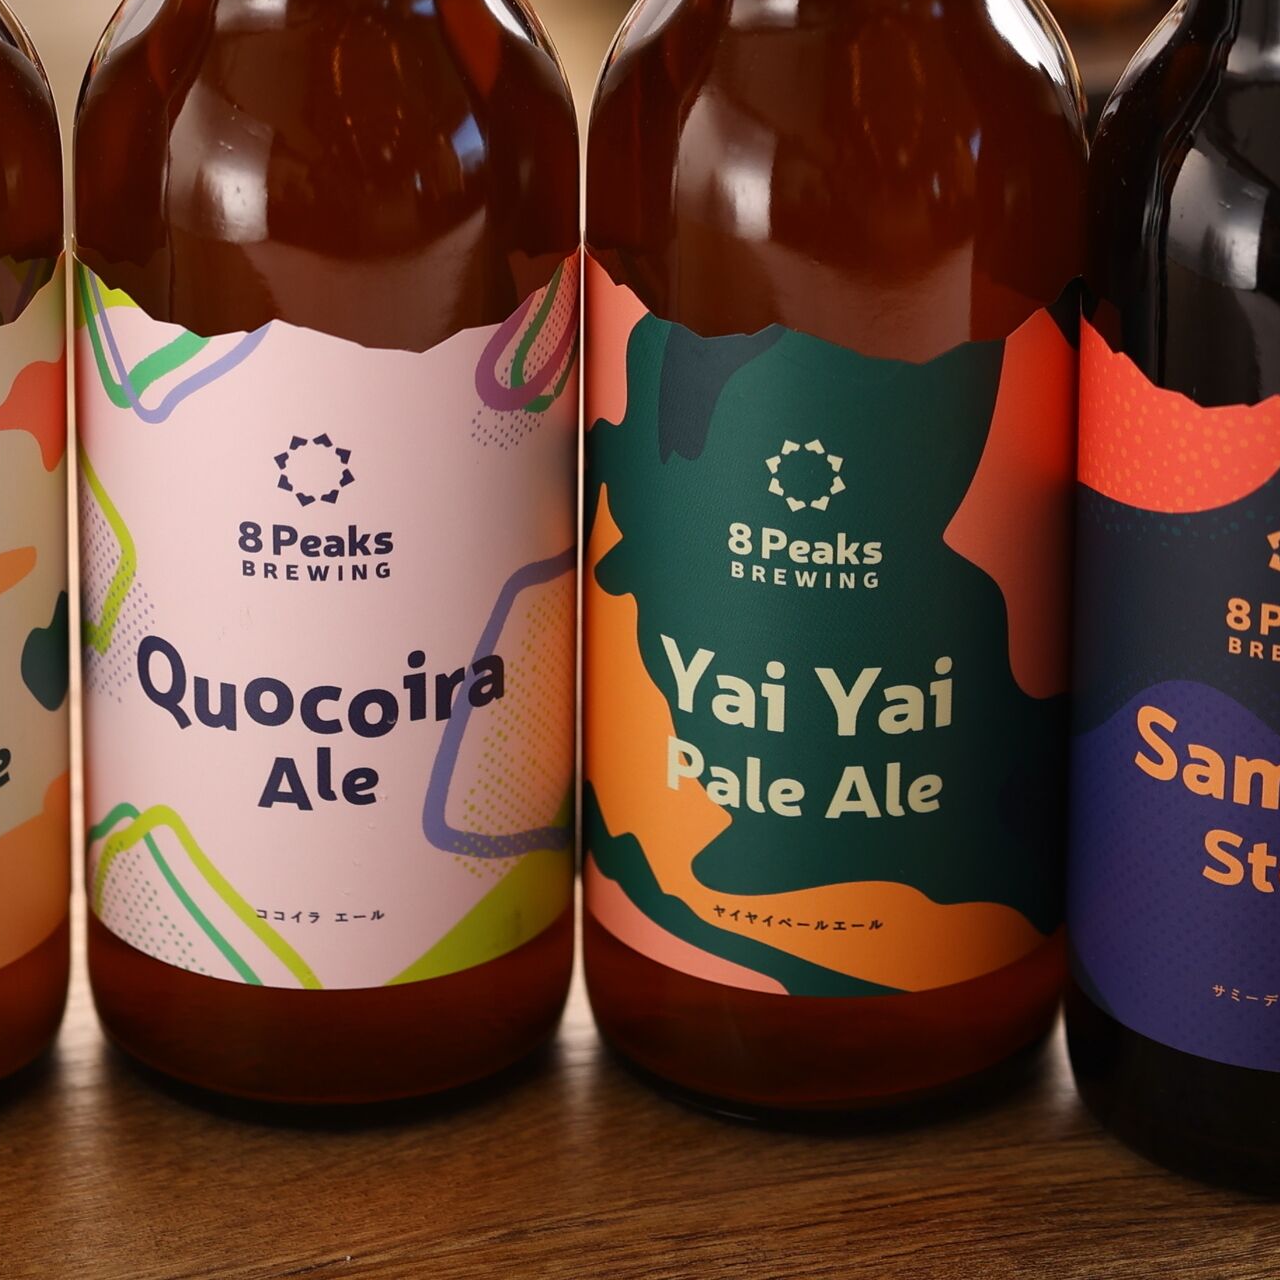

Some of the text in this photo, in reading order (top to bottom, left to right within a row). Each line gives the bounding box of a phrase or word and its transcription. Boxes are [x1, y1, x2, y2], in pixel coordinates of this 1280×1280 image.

[239, 521, 393, 558] 8 Peaks
[728, 522, 883, 565] 8 Peaks
[242, 559, 391, 582] BREWING
[731, 560, 879, 589] BREWING
[1226, 598, 1252, 631] 8
[137, 636, 505, 737] Quocoira
[661, 634, 953, 736] Yai Yai
[257, 747, 379, 811] Ale
[667, 735, 943, 820] Pale Ale
[256, 909, 384, 923] ココイラ エール
[1212, 984, 1279, 1006] サミーデ
